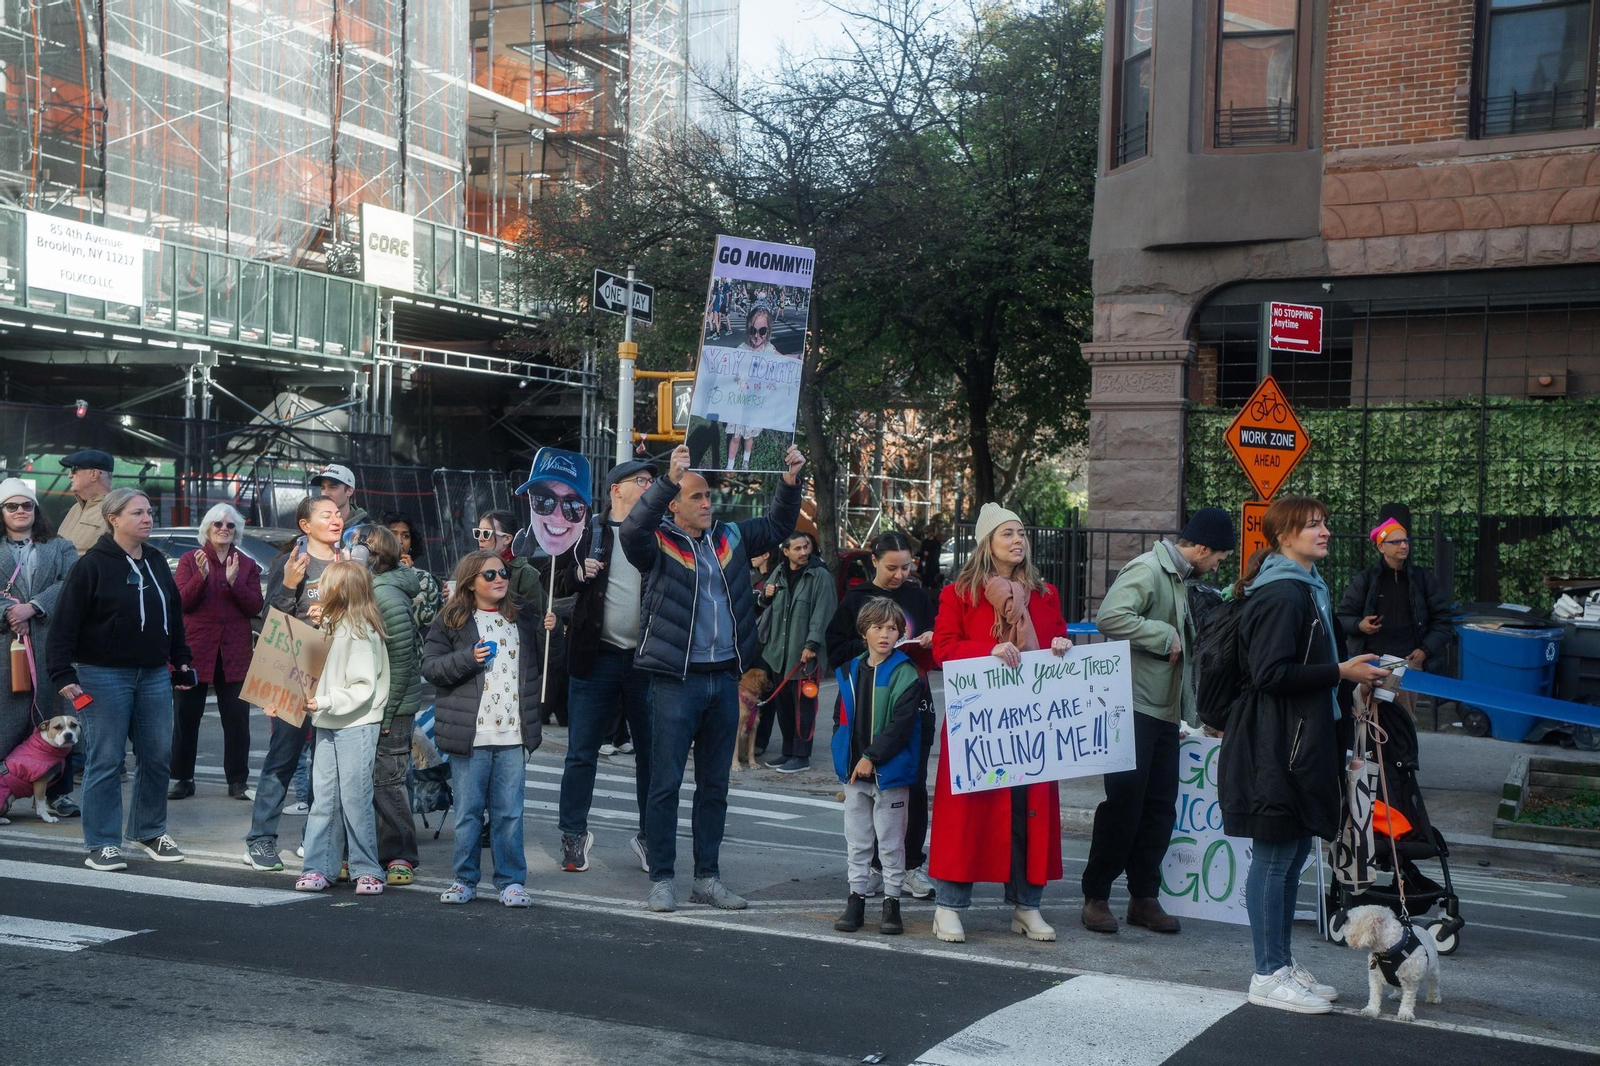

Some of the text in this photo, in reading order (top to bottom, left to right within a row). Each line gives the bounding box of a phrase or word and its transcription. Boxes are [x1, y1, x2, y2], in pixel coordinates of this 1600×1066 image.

[50, 223, 123, 249] 85 4th Avenue
[369, 232, 410, 258] CORE
[36, 236, 135, 266] Brooklyn, NY 11217
[719, 246, 813, 276] GO MOMMY!!!
[605, 285, 621, 302] ONE
[1273, 307, 1313, 320] NO STOPPING
[1273, 318, 1299, 329] Anytime
[1240, 430, 1295, 447] WORK ZONE
[1254, 453, 1281, 468] AHEAD
[948, 672, 977, 696] YOU
[969, 697, 1083, 733] MY ARMS ARE
[1056, 711, 1108, 762] ME!!!
[1159, 836, 1237, 903] GO
